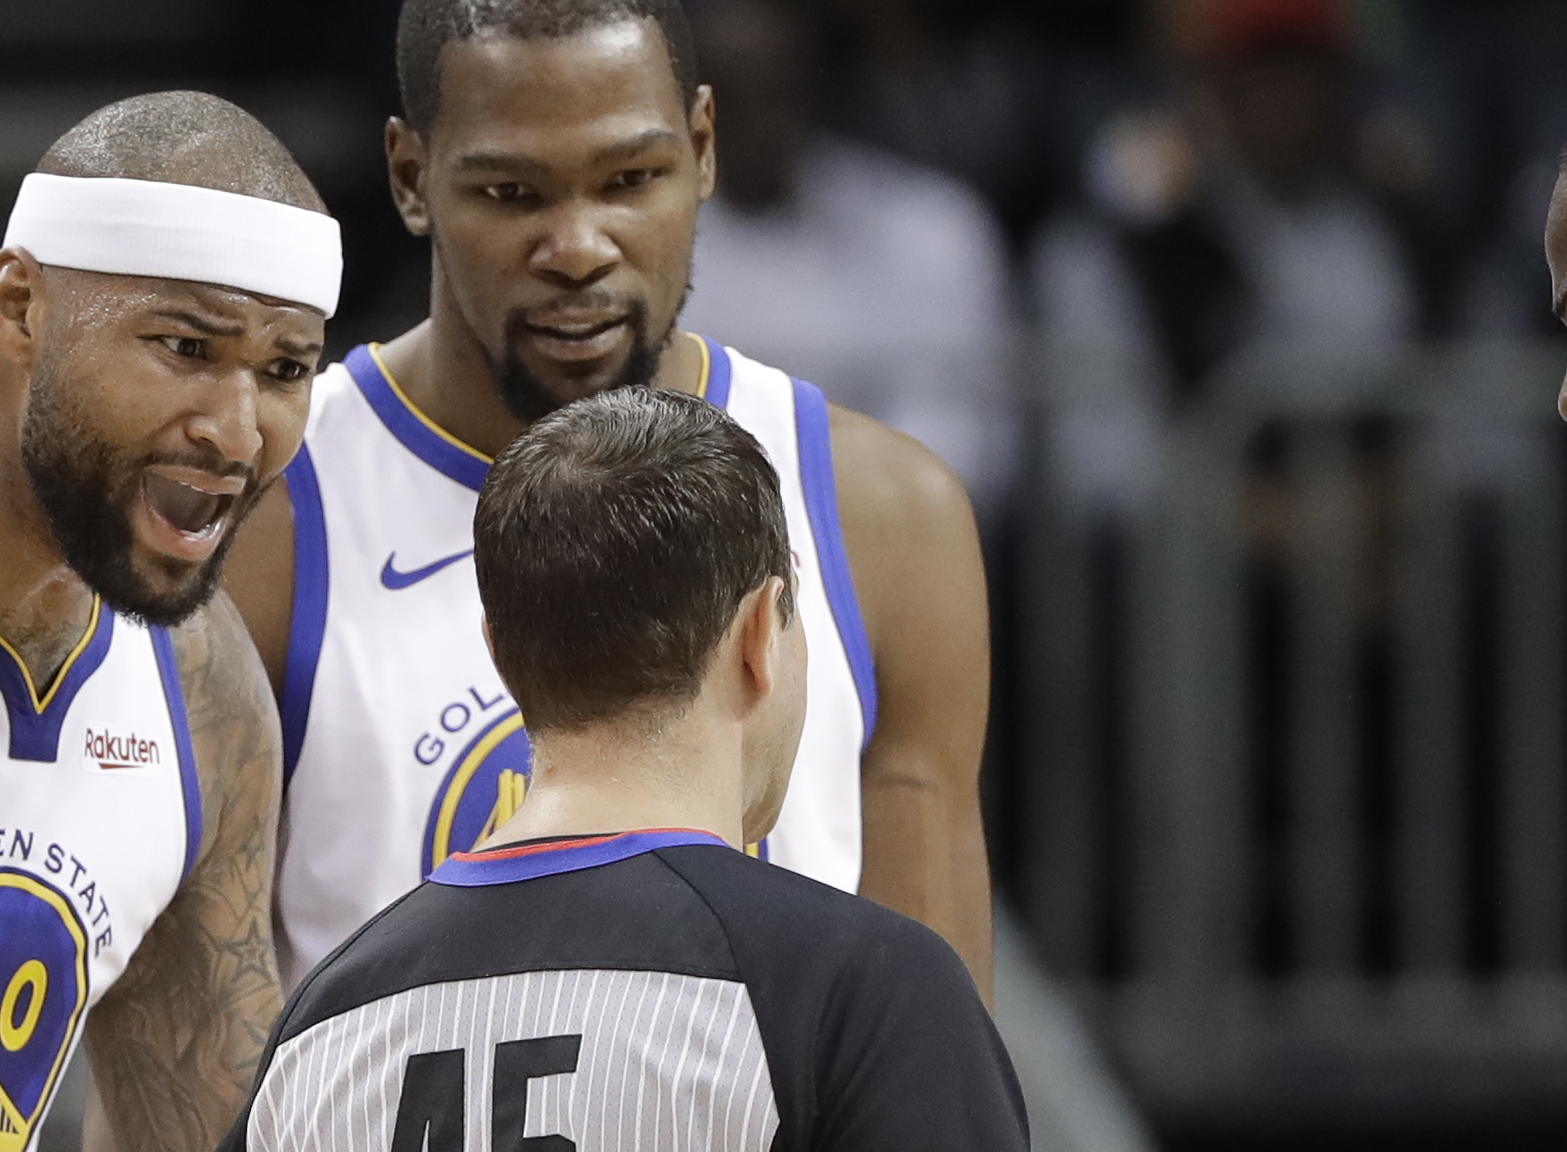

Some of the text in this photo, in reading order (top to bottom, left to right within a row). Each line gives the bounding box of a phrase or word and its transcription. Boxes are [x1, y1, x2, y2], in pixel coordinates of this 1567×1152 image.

[84, 728, 160, 764] Rakuten
[414, 685, 505, 766] GOL
[44, 842, 113, 959] STATE
